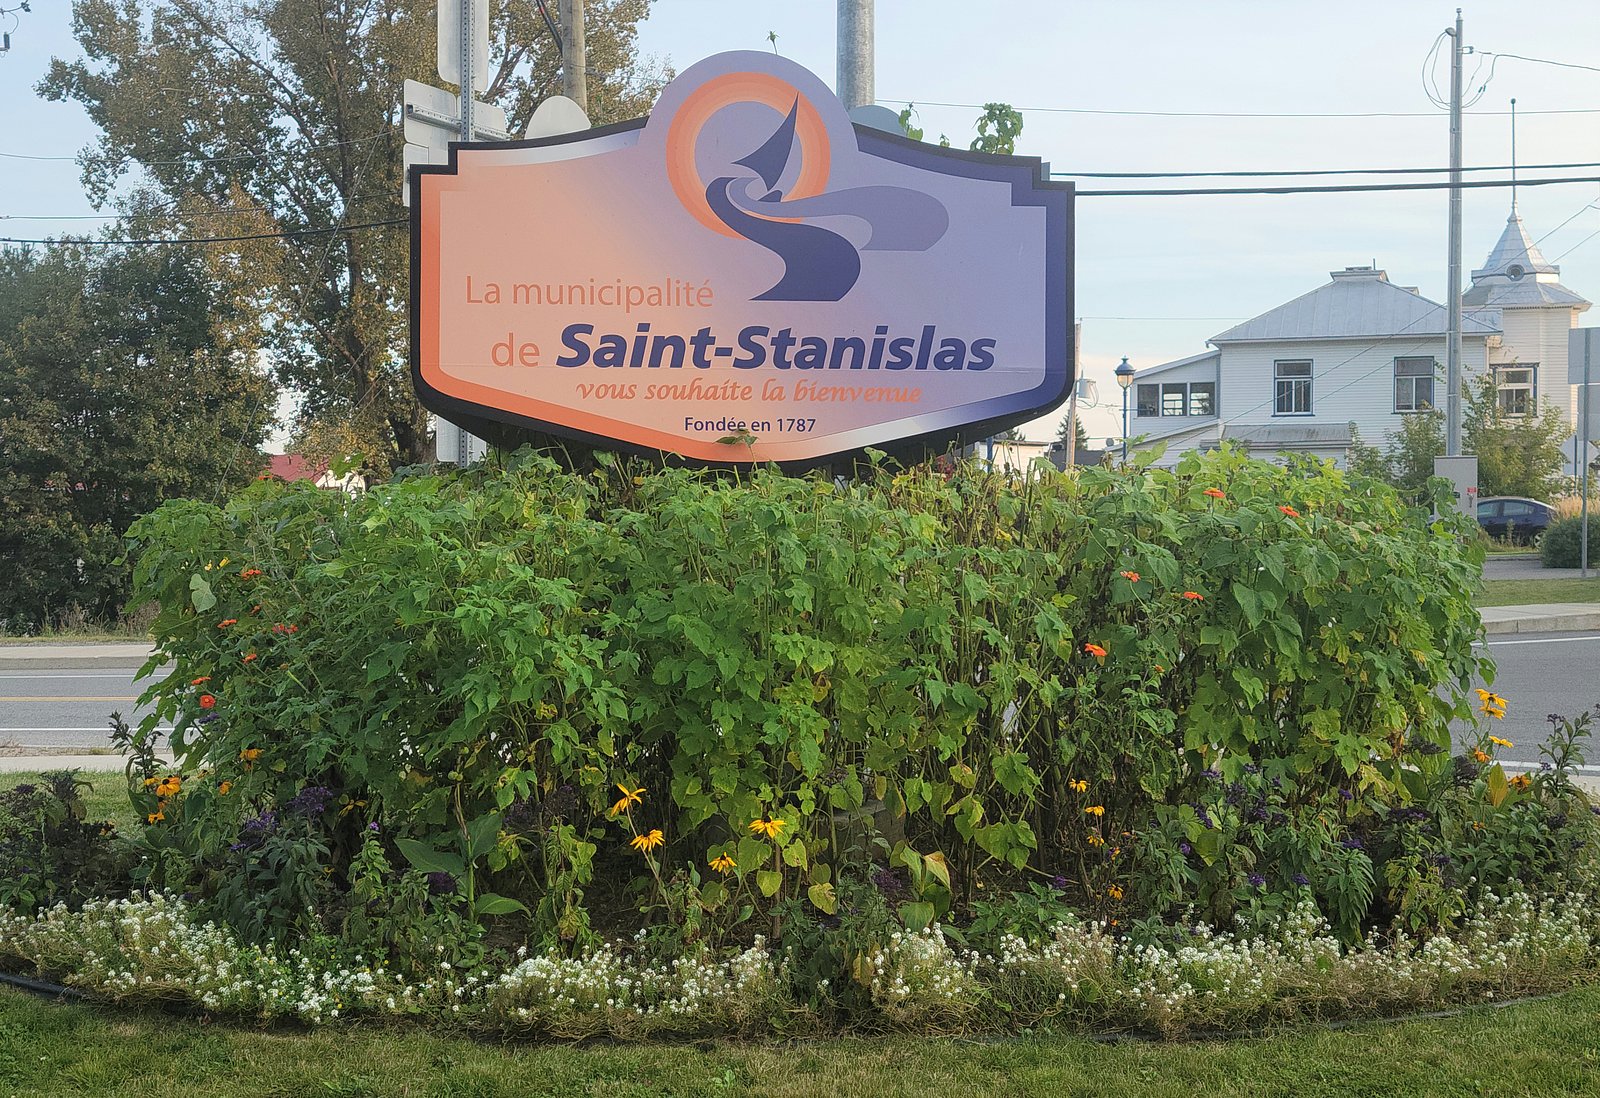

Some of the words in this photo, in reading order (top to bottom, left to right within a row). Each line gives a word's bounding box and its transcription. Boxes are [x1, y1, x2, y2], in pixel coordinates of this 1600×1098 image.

[466, 276, 501, 304] La
[513, 278, 714, 314] municipalité
[491, 332, 540, 368] de
[556, 323, 997, 371] Saint-Stanislas
[576, 382, 637, 400] vous
[644, 376, 753, 401] souhaite
[762, 378, 786, 402] la
[794, 378, 923, 404] bienvenue
[685, 417, 747, 432] Fondée
[751, 420, 772, 432] en
[777, 418, 817, 432] 1787
